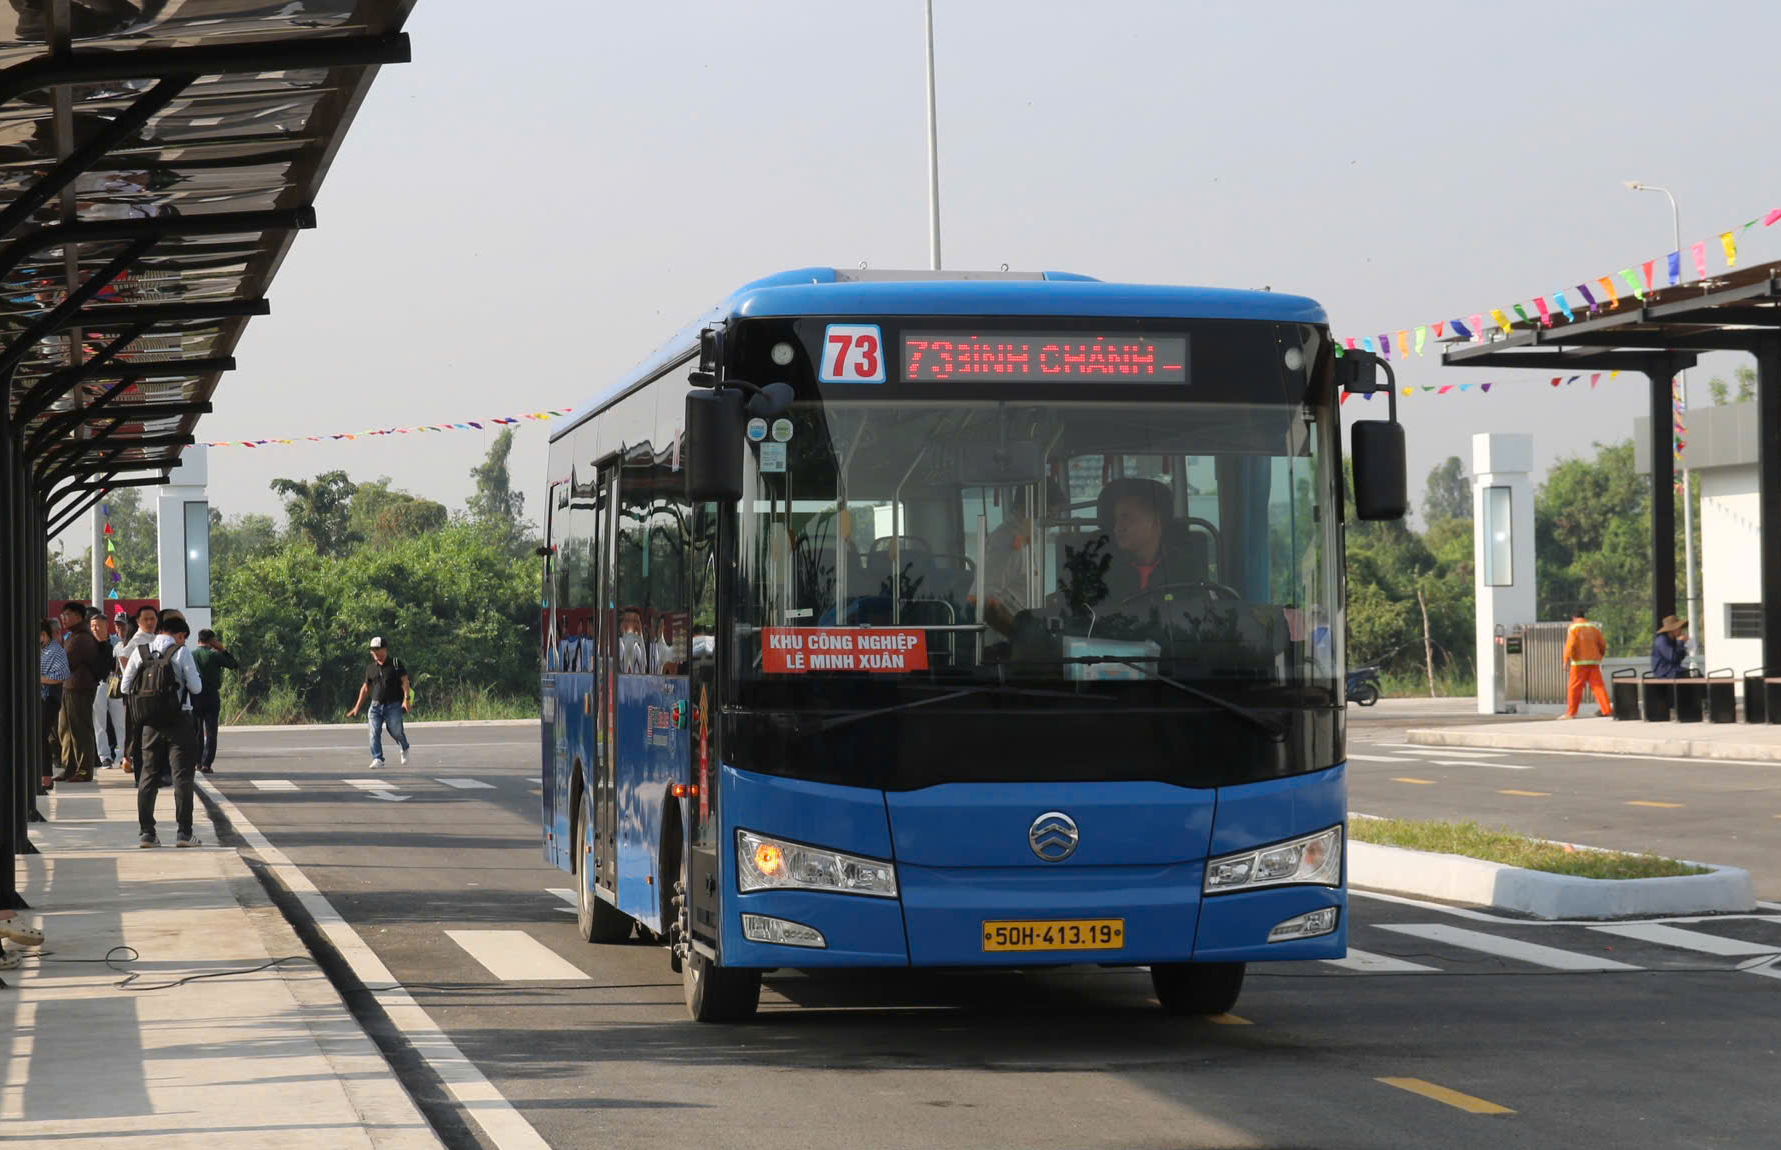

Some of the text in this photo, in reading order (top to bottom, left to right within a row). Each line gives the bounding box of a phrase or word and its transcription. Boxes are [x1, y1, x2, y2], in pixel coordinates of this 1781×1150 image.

[828, 335, 877, 377] 73
[906, 341, 953, 378] 73
[769, 632, 918, 653] KHU CÔNG NGHIỆP
[786, 652, 905, 669] LÊ MINH XUÂN
[996, 925, 1112, 946] 50H-413.19
